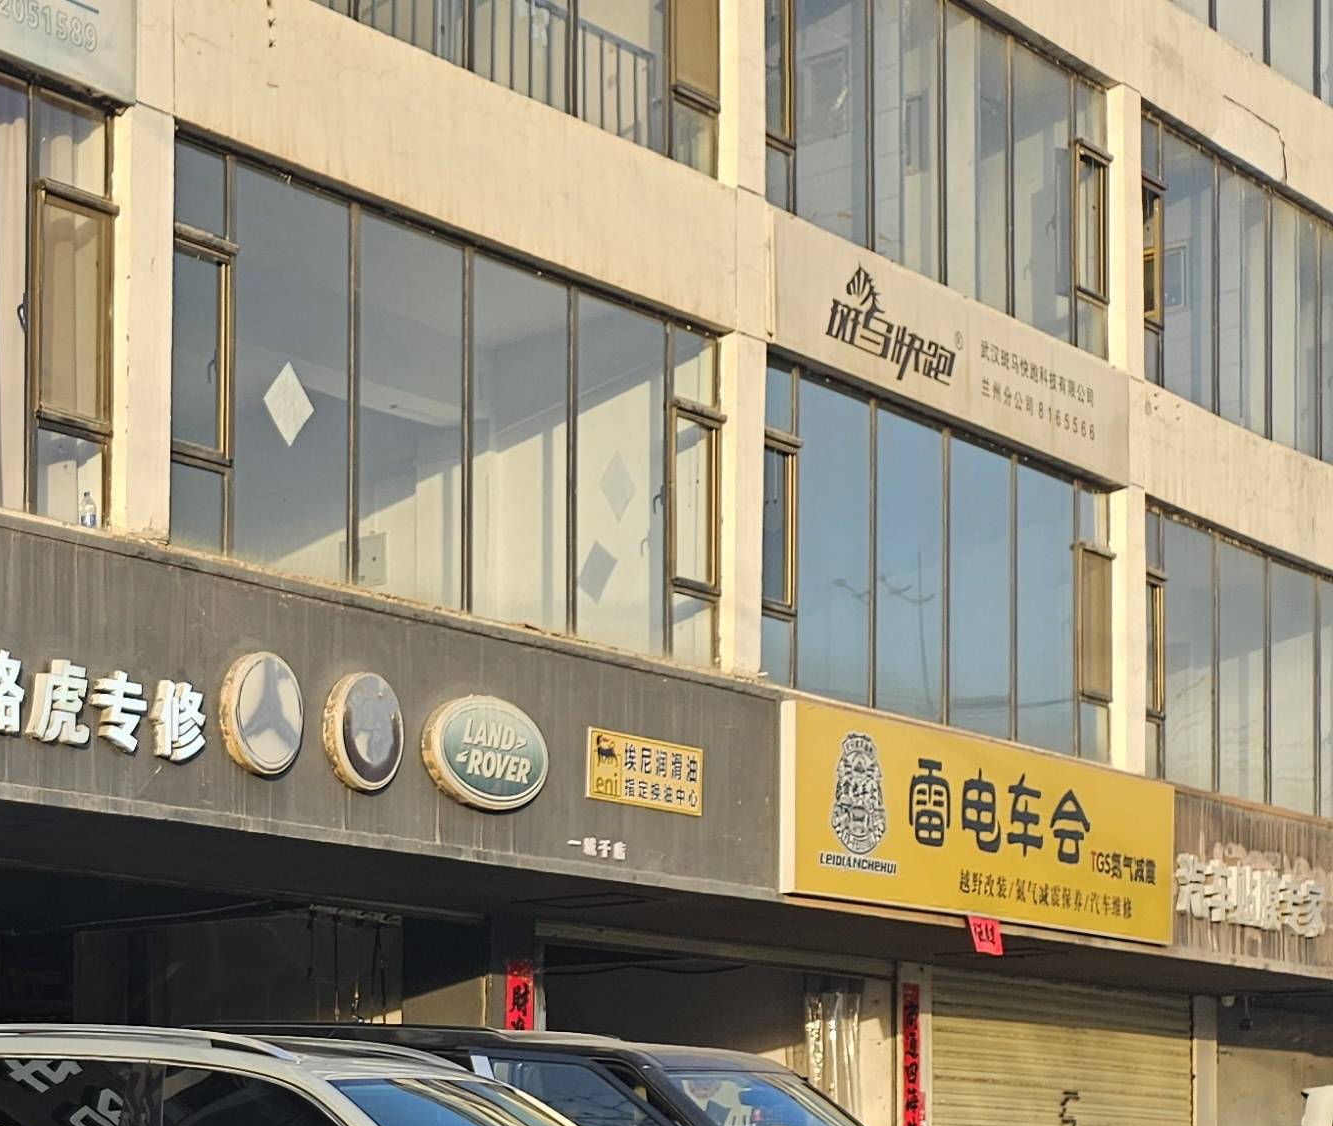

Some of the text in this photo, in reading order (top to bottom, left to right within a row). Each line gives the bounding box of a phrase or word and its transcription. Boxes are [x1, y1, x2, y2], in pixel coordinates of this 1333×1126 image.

[462, 718, 517, 752] LAND
[465, 748, 532, 785] ROVER
[908, 757, 1091, 865] 雷电车会
